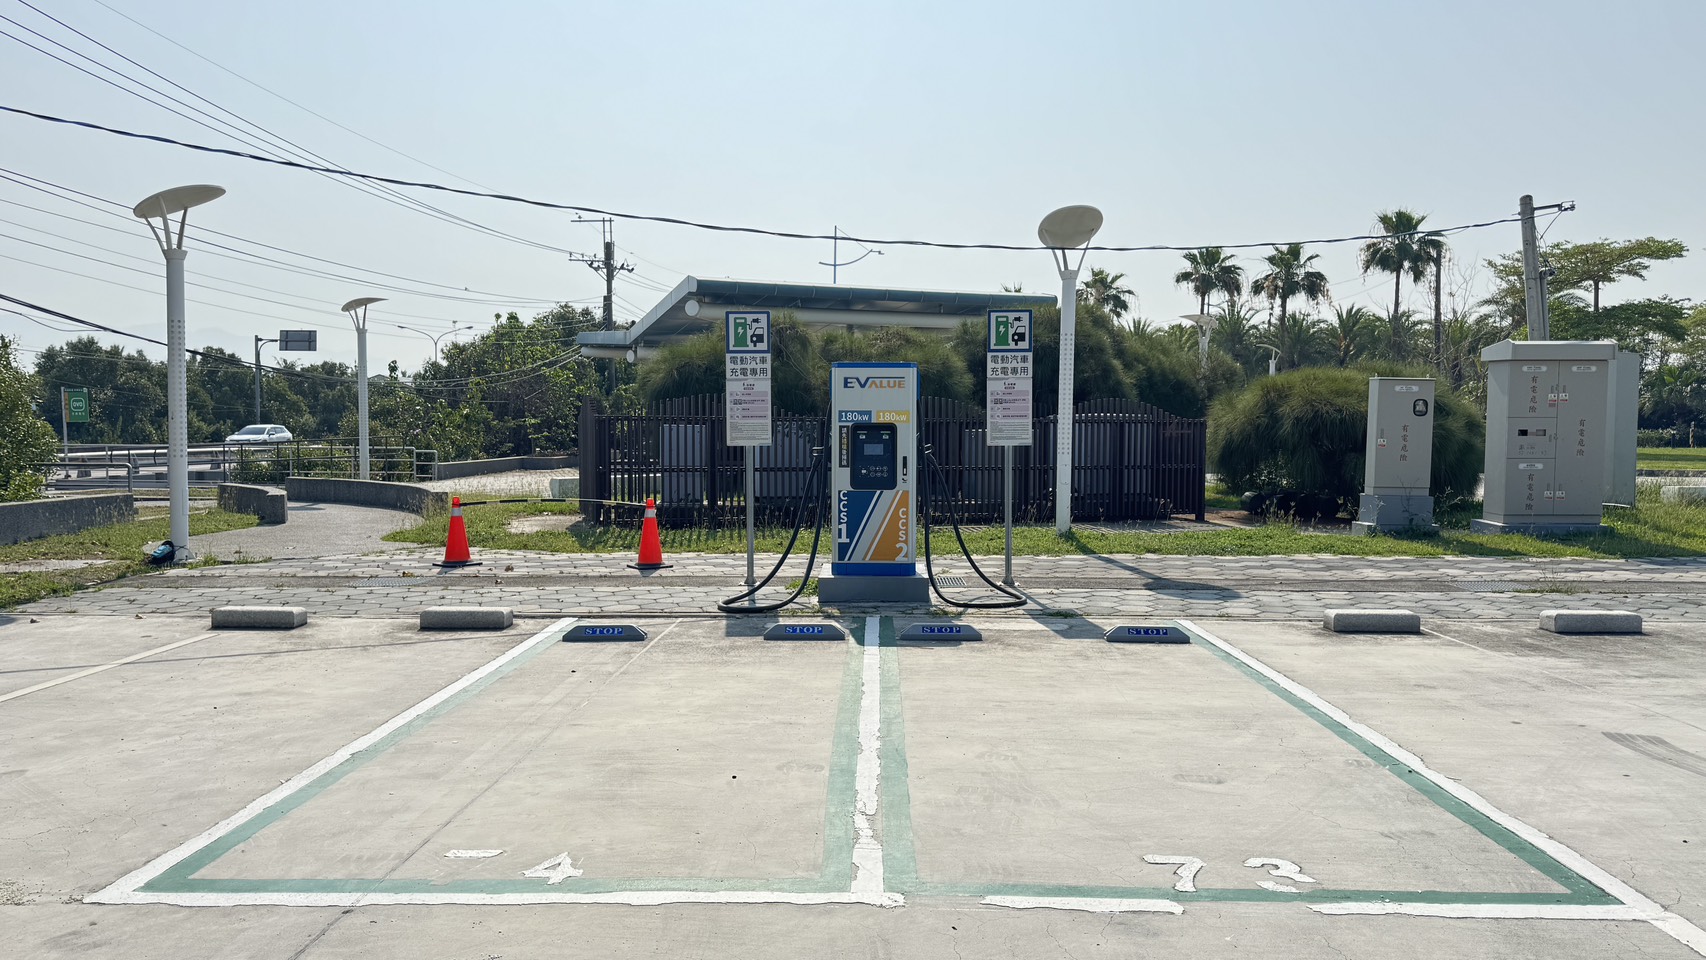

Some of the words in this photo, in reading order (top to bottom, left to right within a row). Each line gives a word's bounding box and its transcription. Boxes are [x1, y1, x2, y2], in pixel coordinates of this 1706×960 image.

[729, 355, 768, 366] 電動汽車
[990, 354, 1029, 365] 電動汽車
[729, 367, 768, 378] 充電專用
[990, 366, 1029, 377] 充電專用
[1528, 374, 1539, 414] 有電危險
[1399, 423, 1410, 462] 有電危險
[1575, 418, 1587, 457] 有電危險
[1525, 472, 1535, 511] 有電危險
[585, 627, 624, 636] STOP
[784, 625, 823, 634] STOP
[921, 626, 961, 634] STOP
[1128, 627, 1168, 636] STOP
